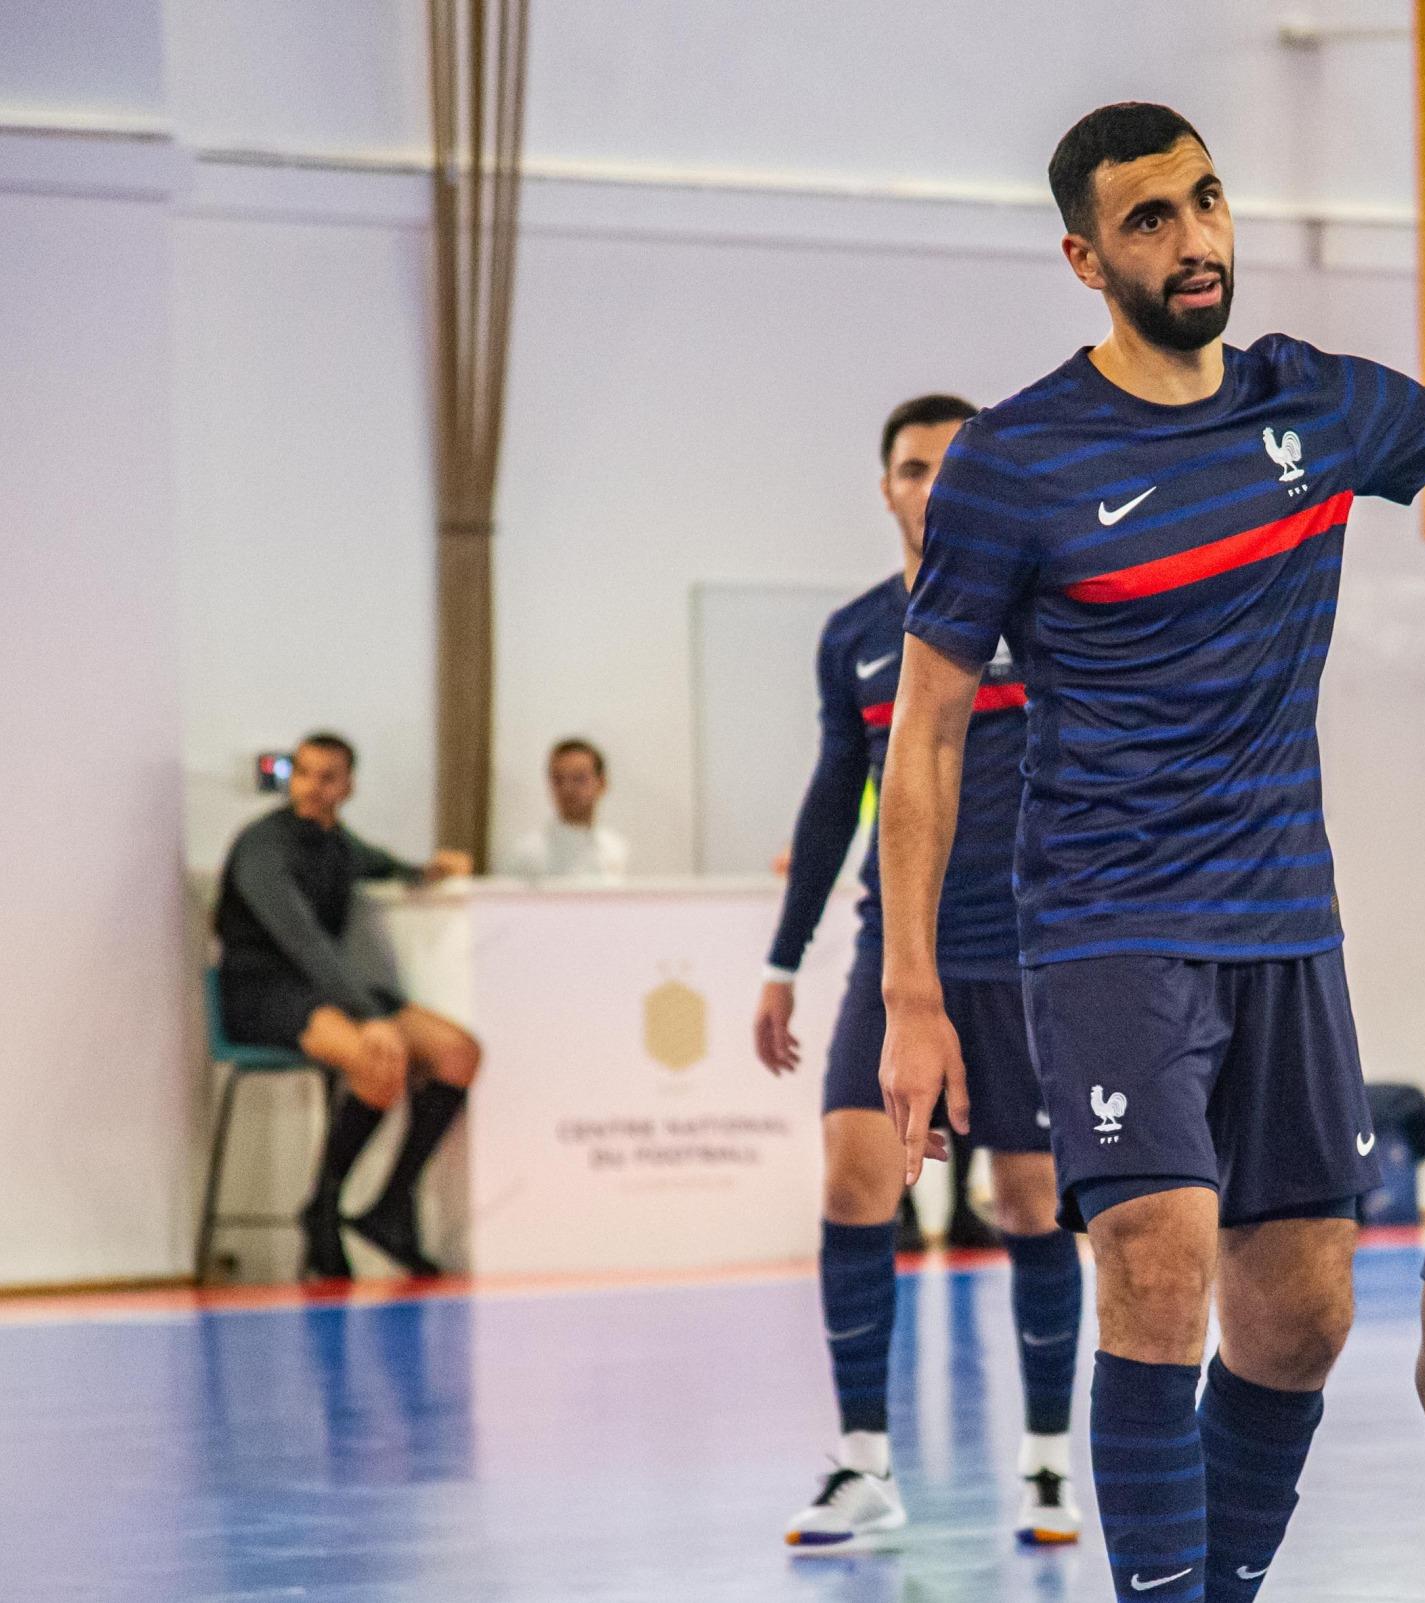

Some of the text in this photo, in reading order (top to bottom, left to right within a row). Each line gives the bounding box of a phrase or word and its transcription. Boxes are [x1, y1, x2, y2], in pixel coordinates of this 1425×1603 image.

[554, 1115, 790, 1144] CENTRE NATIONAL
[588, 1147, 760, 1171] DU FOOTBALL
